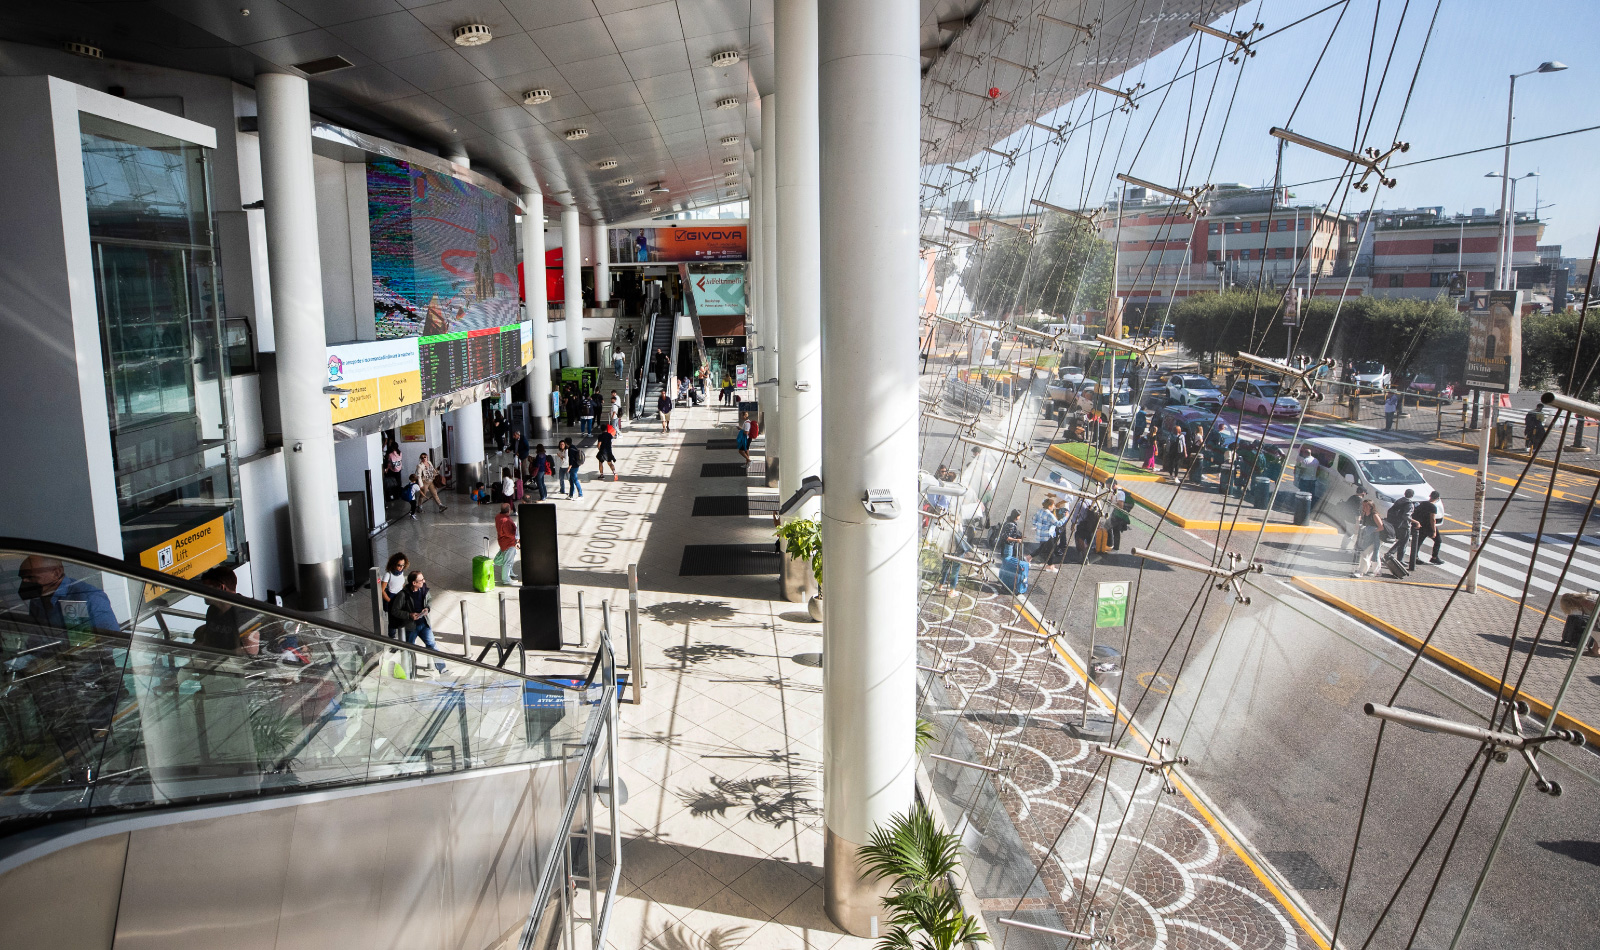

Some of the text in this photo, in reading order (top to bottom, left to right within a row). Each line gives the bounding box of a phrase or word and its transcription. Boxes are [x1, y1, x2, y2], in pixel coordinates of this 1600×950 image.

[687, 231, 742, 240] GIVOVA
[1468, 362, 1491, 373] Divina
[175, 526, 212, 550] Ascensore
[176, 550, 188, 562] Lift
